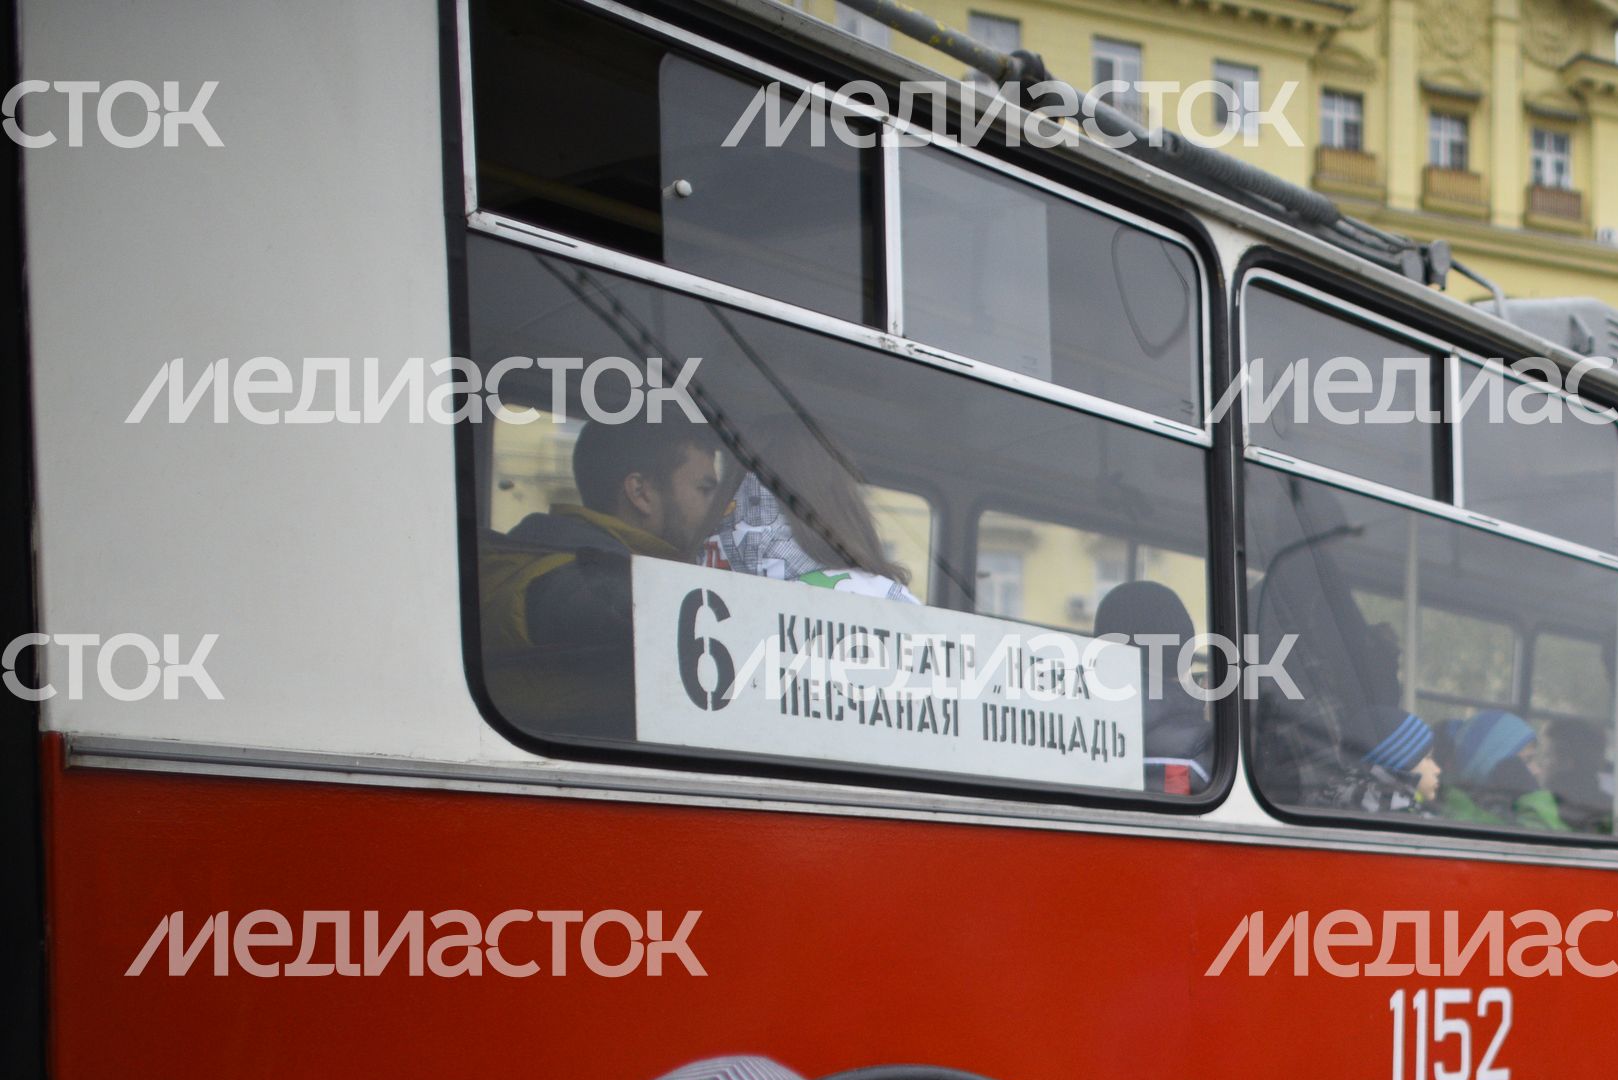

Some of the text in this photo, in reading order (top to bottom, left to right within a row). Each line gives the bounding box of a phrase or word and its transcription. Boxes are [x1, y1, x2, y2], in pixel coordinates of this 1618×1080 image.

[677, 587, 736, 712] 6
[778, 612, 976, 681] КИНОТЕАТР
[779, 667, 1126, 763] ПЕСЧАНАЯ ПЛОЩАДЬ
